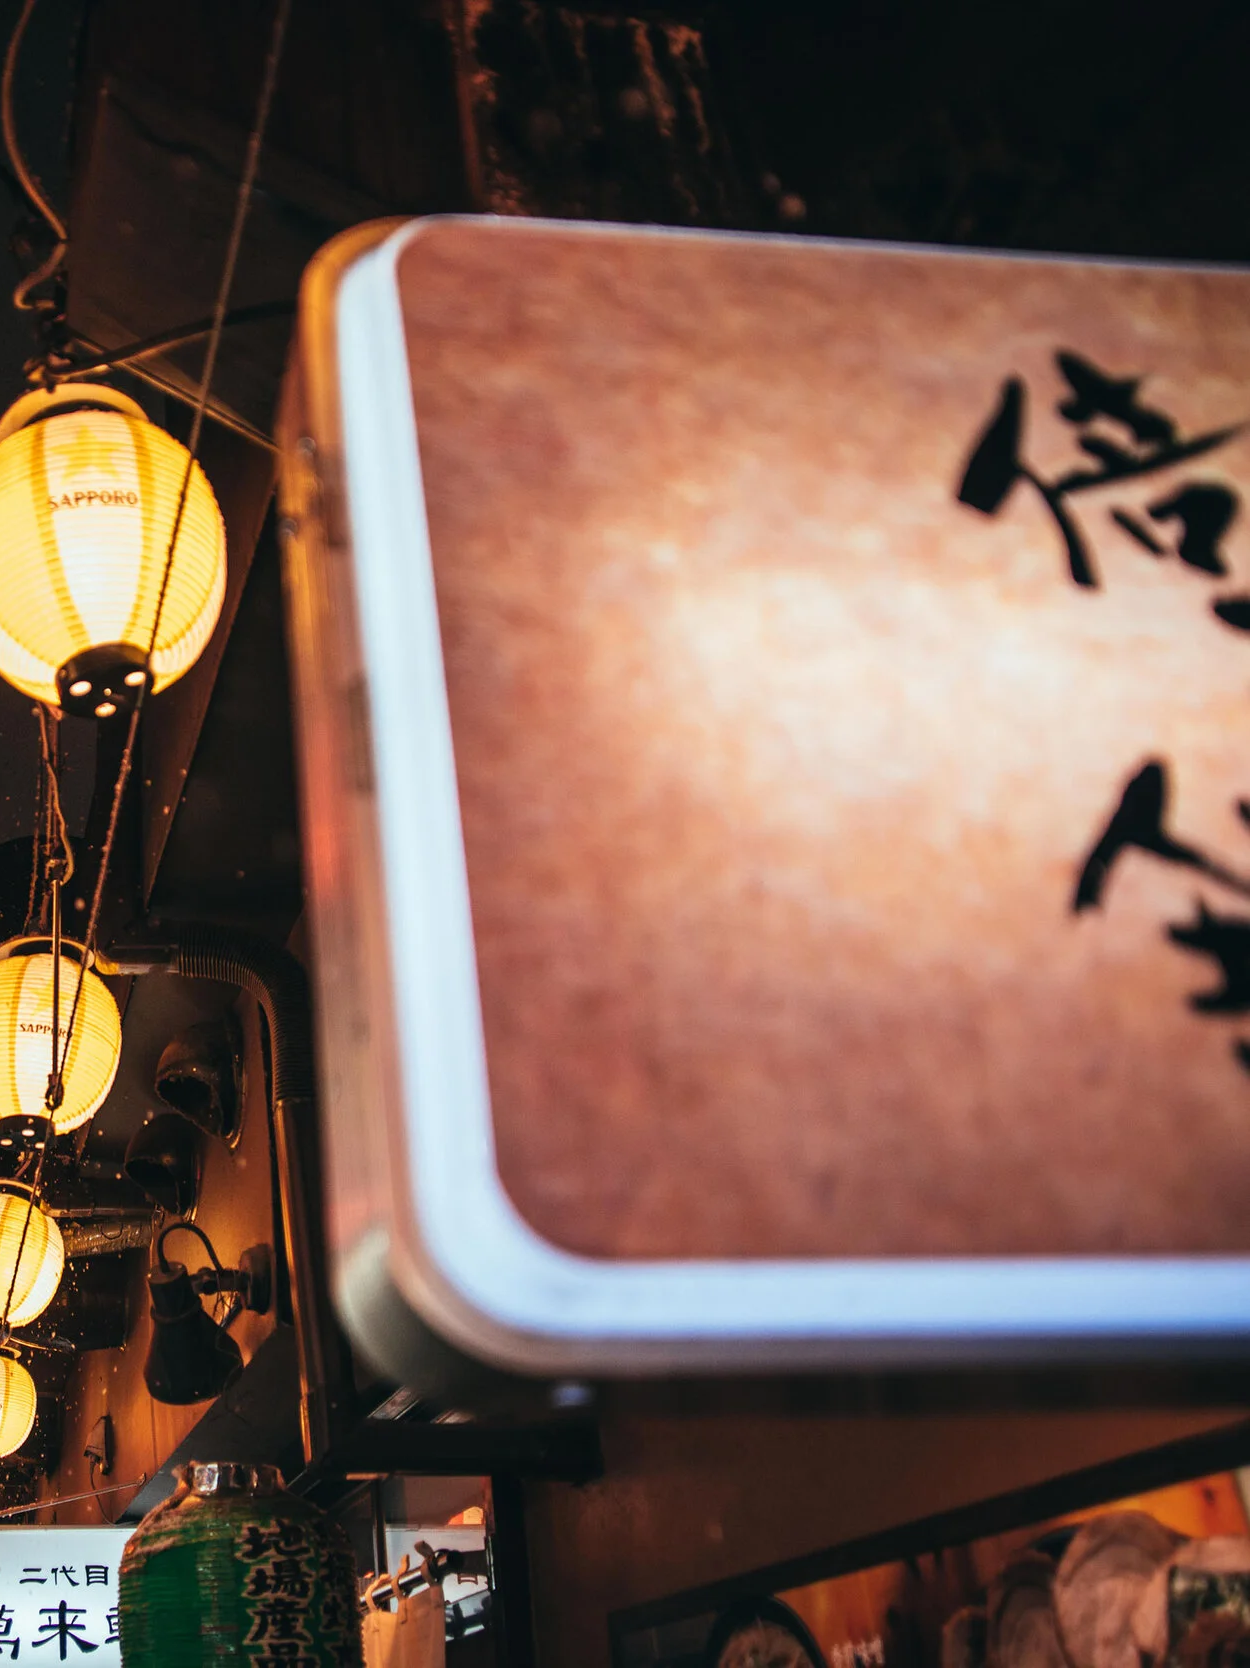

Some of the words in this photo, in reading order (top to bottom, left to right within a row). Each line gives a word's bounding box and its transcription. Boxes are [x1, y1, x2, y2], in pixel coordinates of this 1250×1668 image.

[50, 490, 138, 510] SAPPORO
[19, 1023, 72, 1038] SAPPR
[19, 1565, 109, 1587] 二代目
